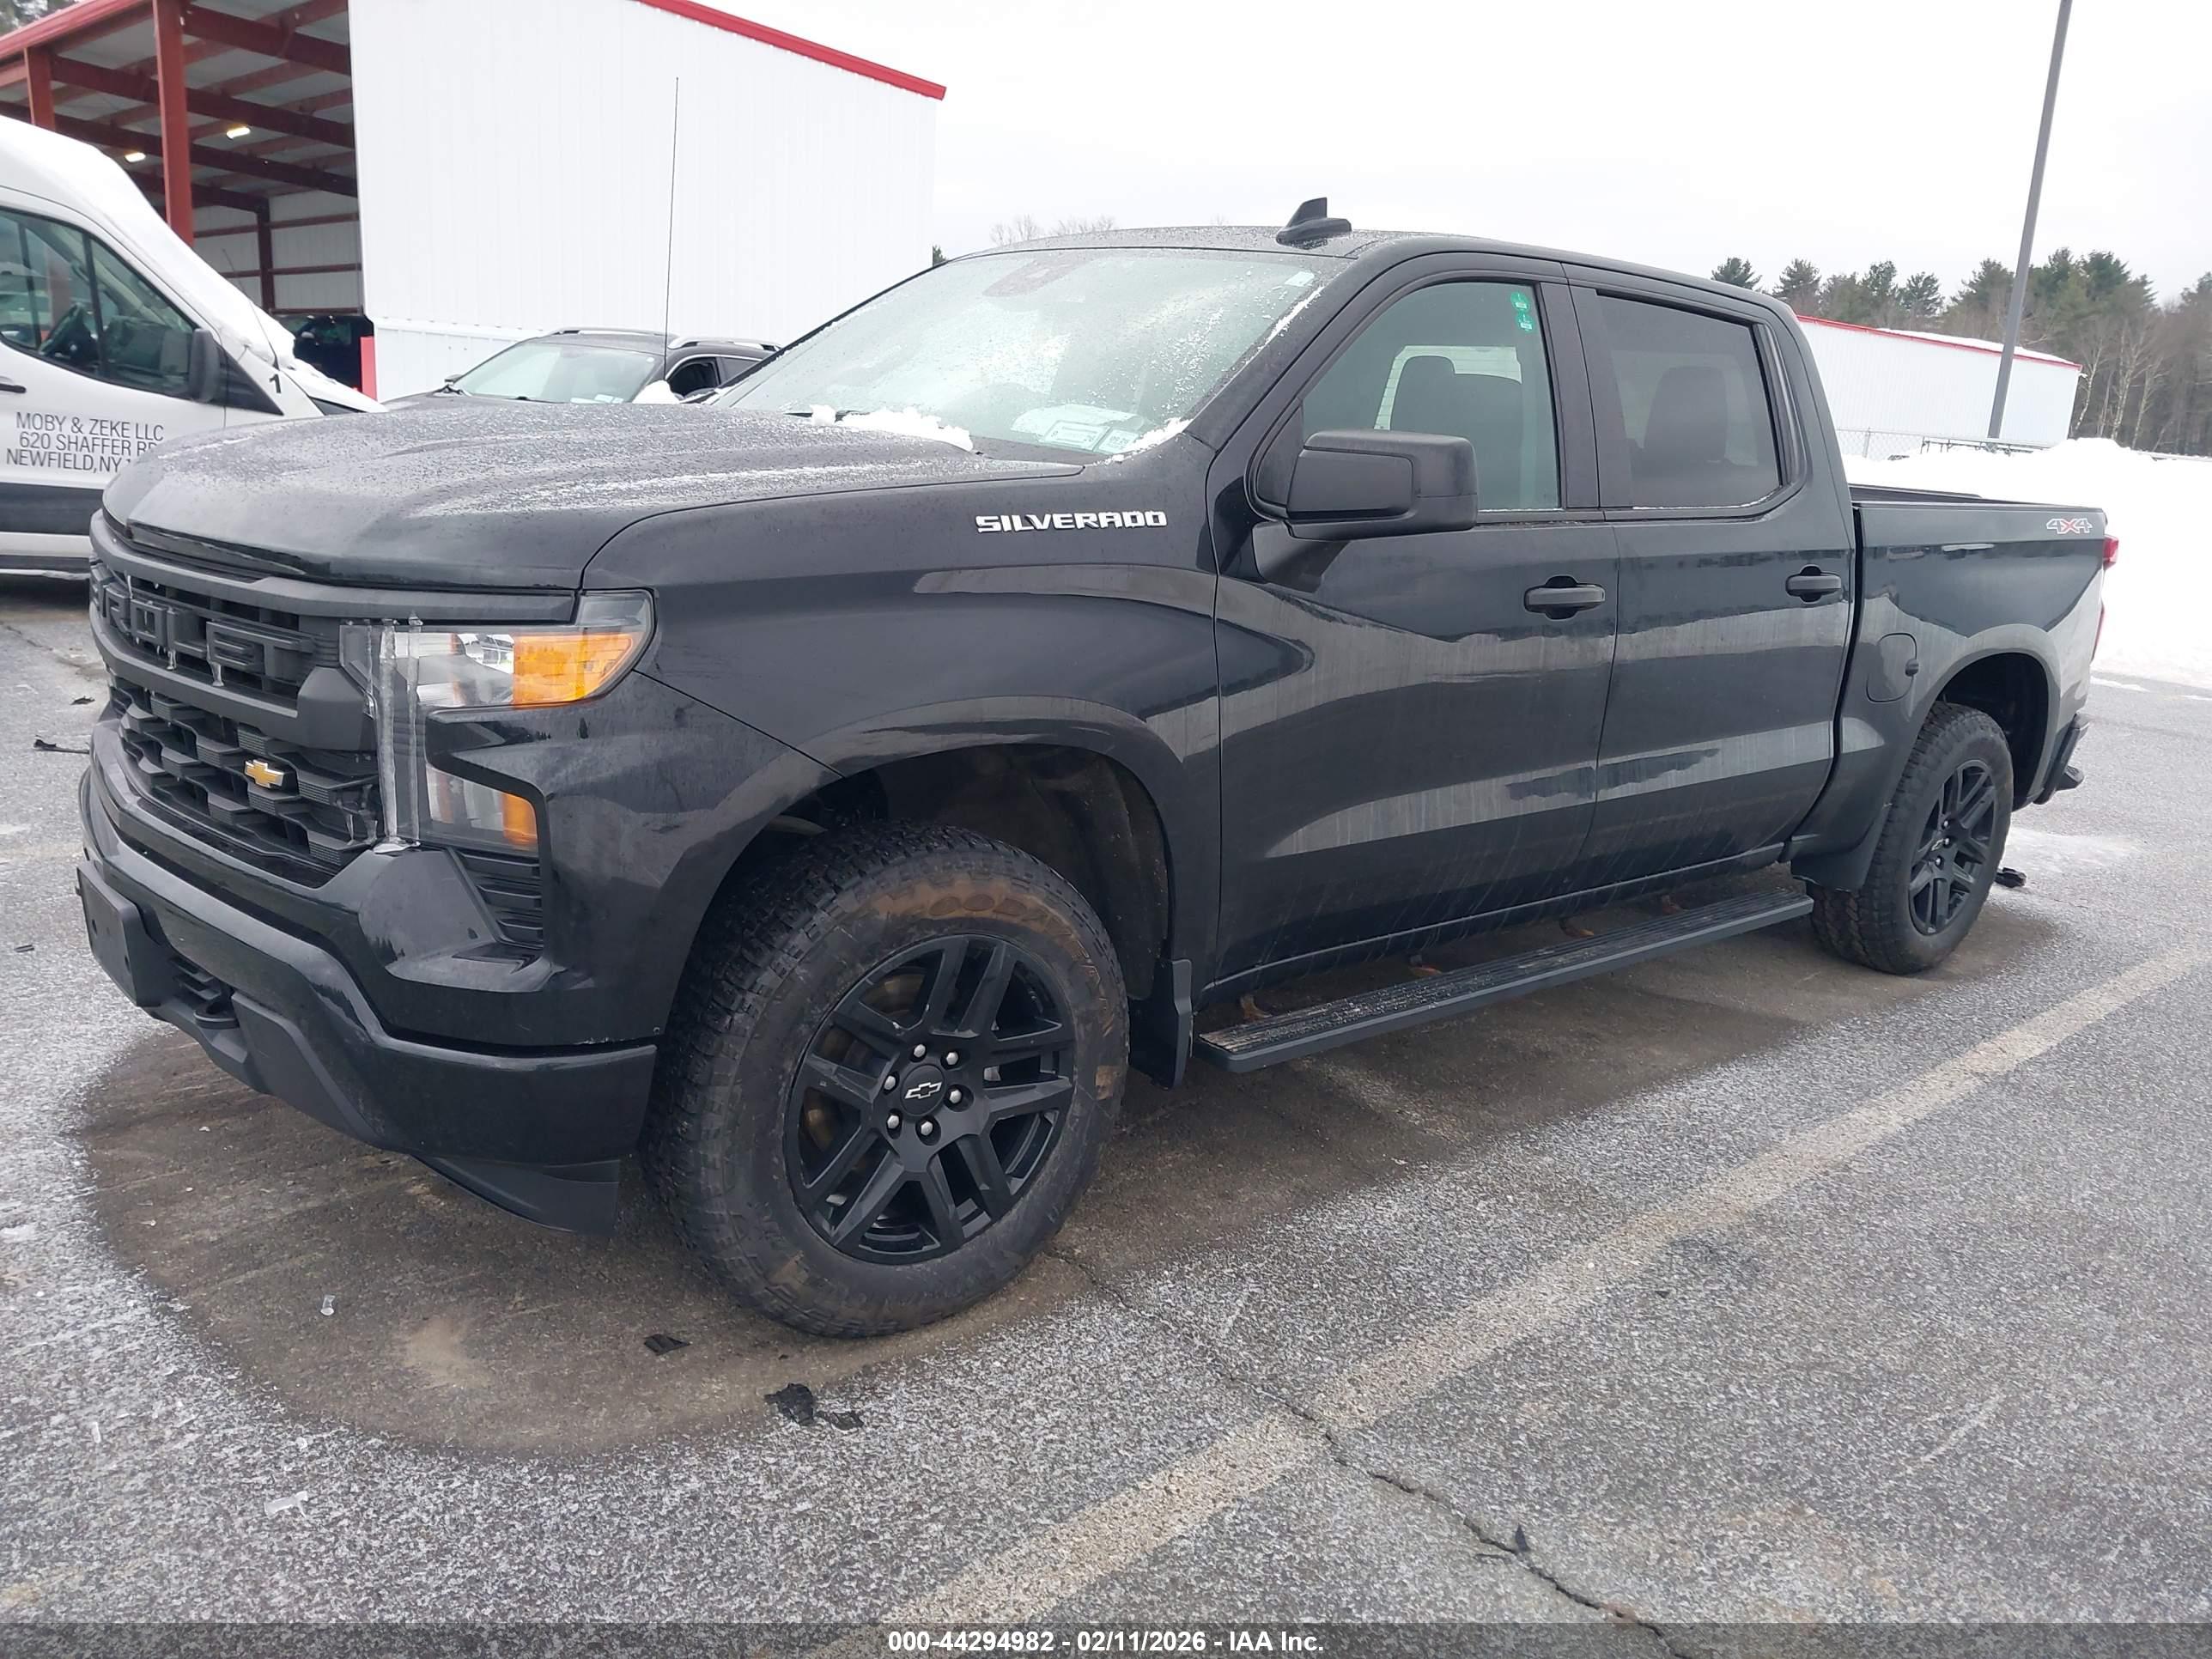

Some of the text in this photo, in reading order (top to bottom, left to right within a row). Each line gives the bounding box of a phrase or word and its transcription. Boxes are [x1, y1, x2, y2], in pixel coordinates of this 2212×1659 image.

[269, 374, 282, 394] 1
[15, 411, 164, 441] MOBY & ZEKE LLC
[19, 431, 52, 450] 620
[55, 434, 131, 456] SHAFFER
[975, 511, 1168, 532] SILVERADO
